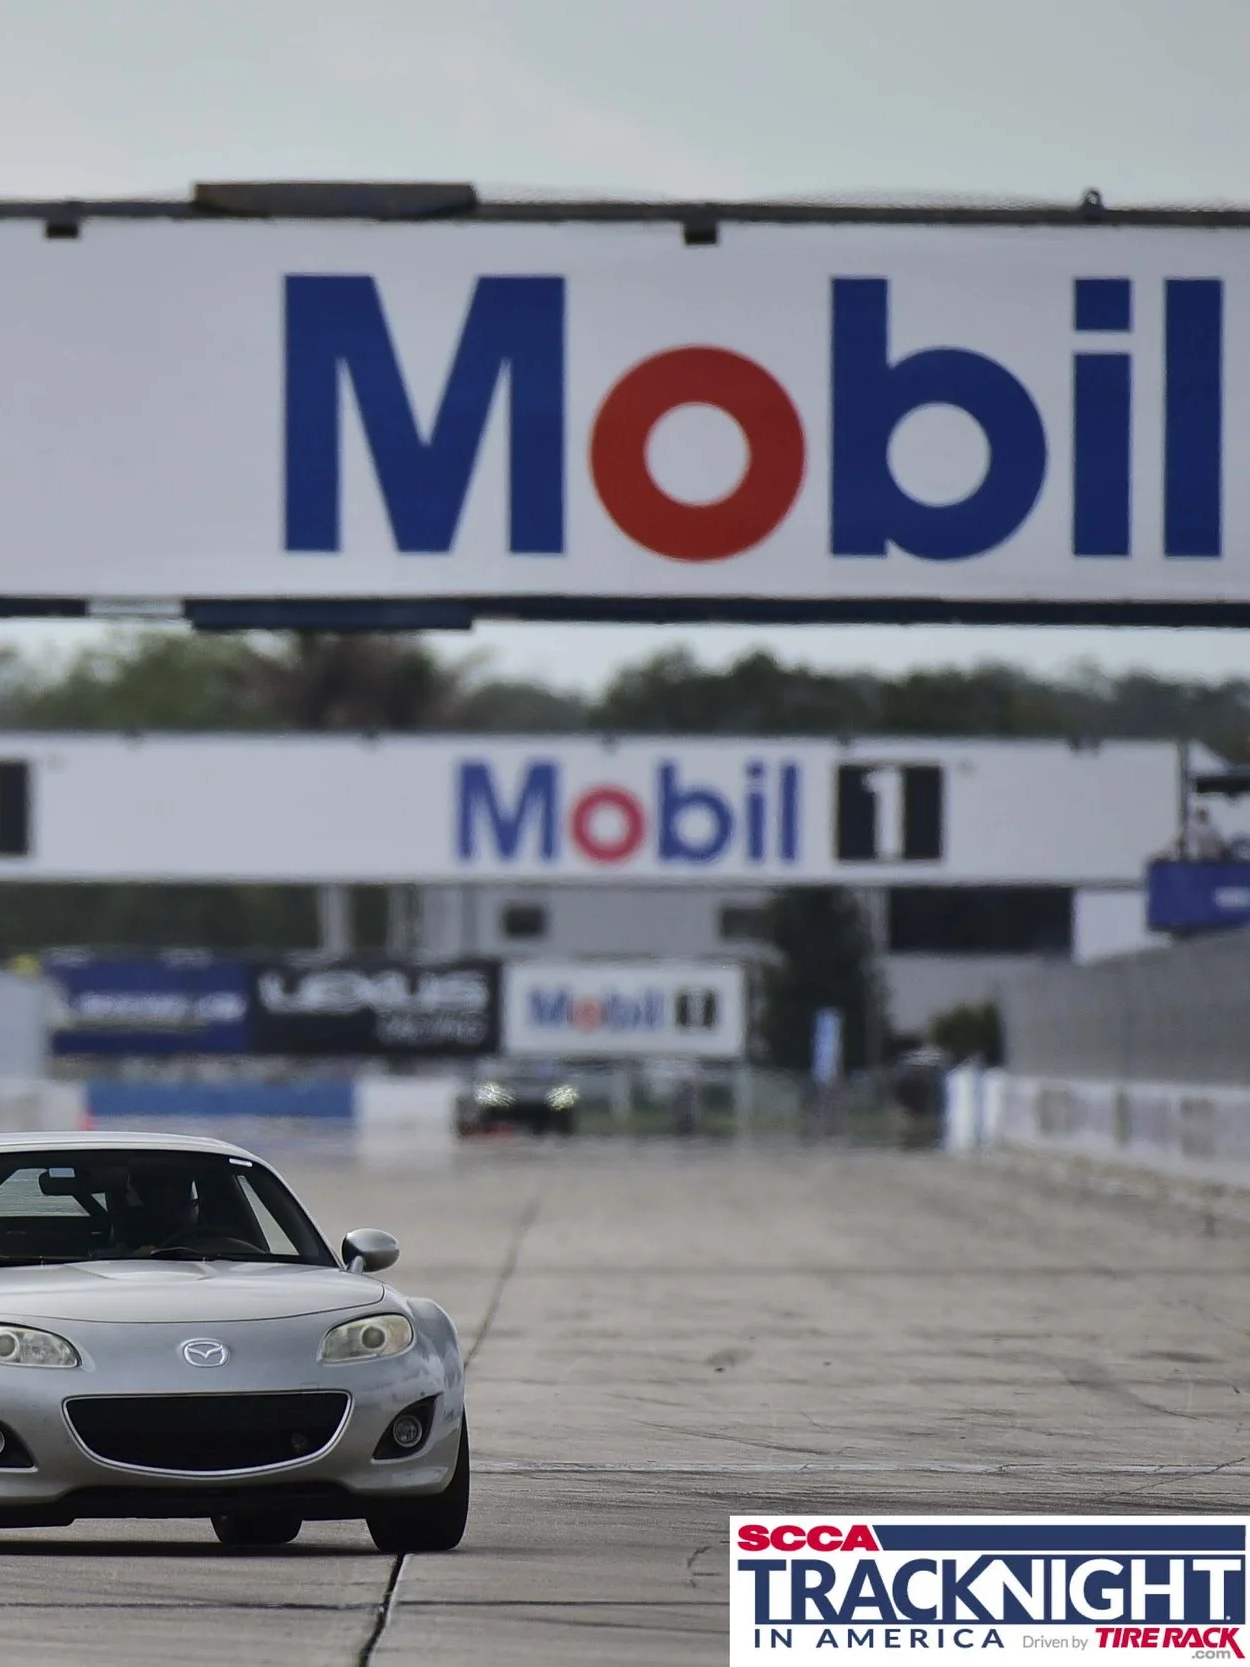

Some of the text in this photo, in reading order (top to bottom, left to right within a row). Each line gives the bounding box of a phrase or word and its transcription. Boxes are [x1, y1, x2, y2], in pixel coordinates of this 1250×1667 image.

[284, 274, 1224, 561] Mobil
[455, 760, 800, 863] Mobil
[527, 986, 666, 1034] Mobil
